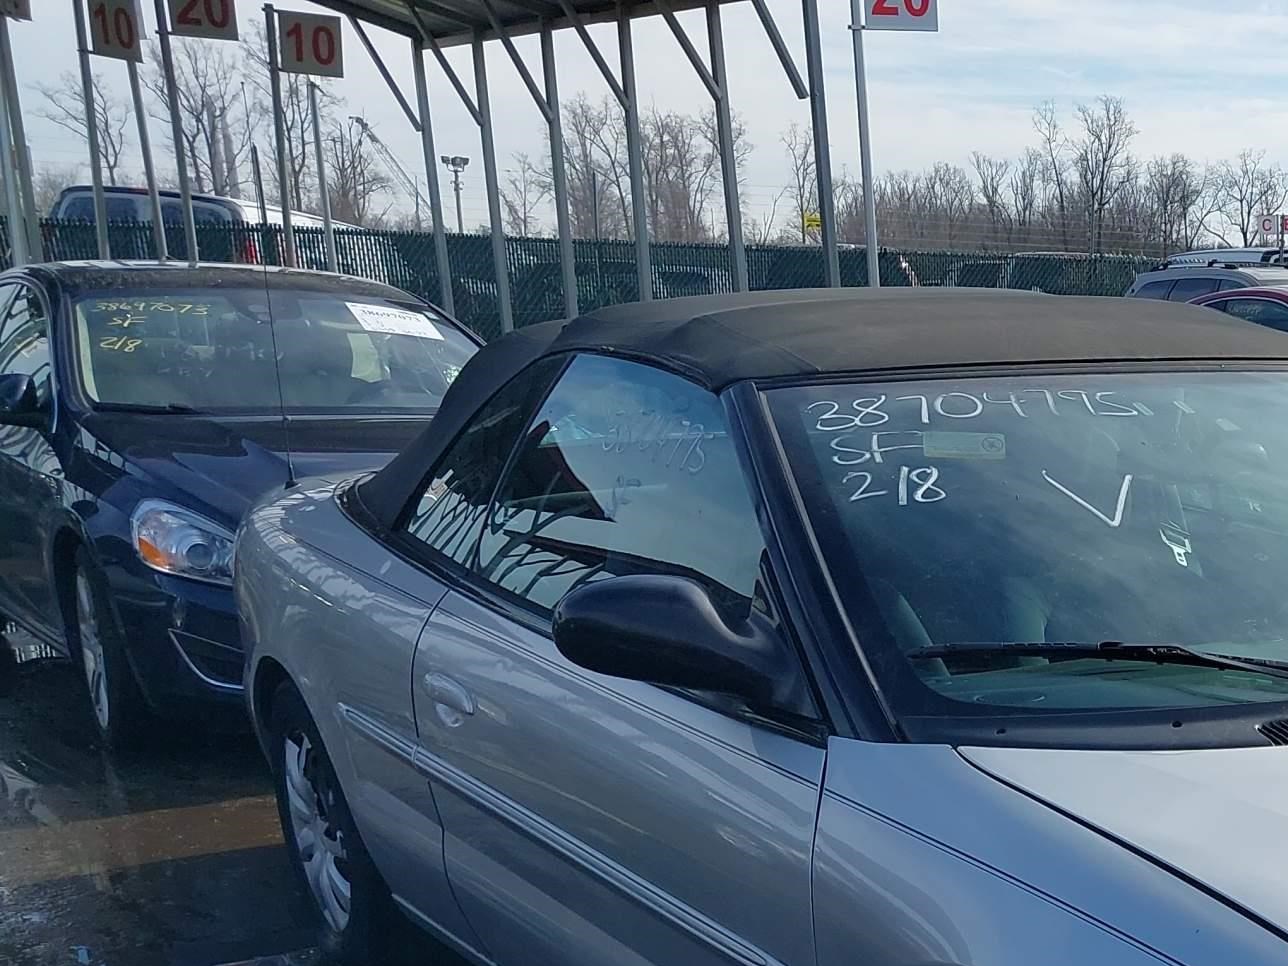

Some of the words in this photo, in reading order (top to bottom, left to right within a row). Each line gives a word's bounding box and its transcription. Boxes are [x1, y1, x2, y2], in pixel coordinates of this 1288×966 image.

[94, 3, 134, 49] 10
[286, 22, 336, 66] 10
[829, 430, 925, 465] SF
